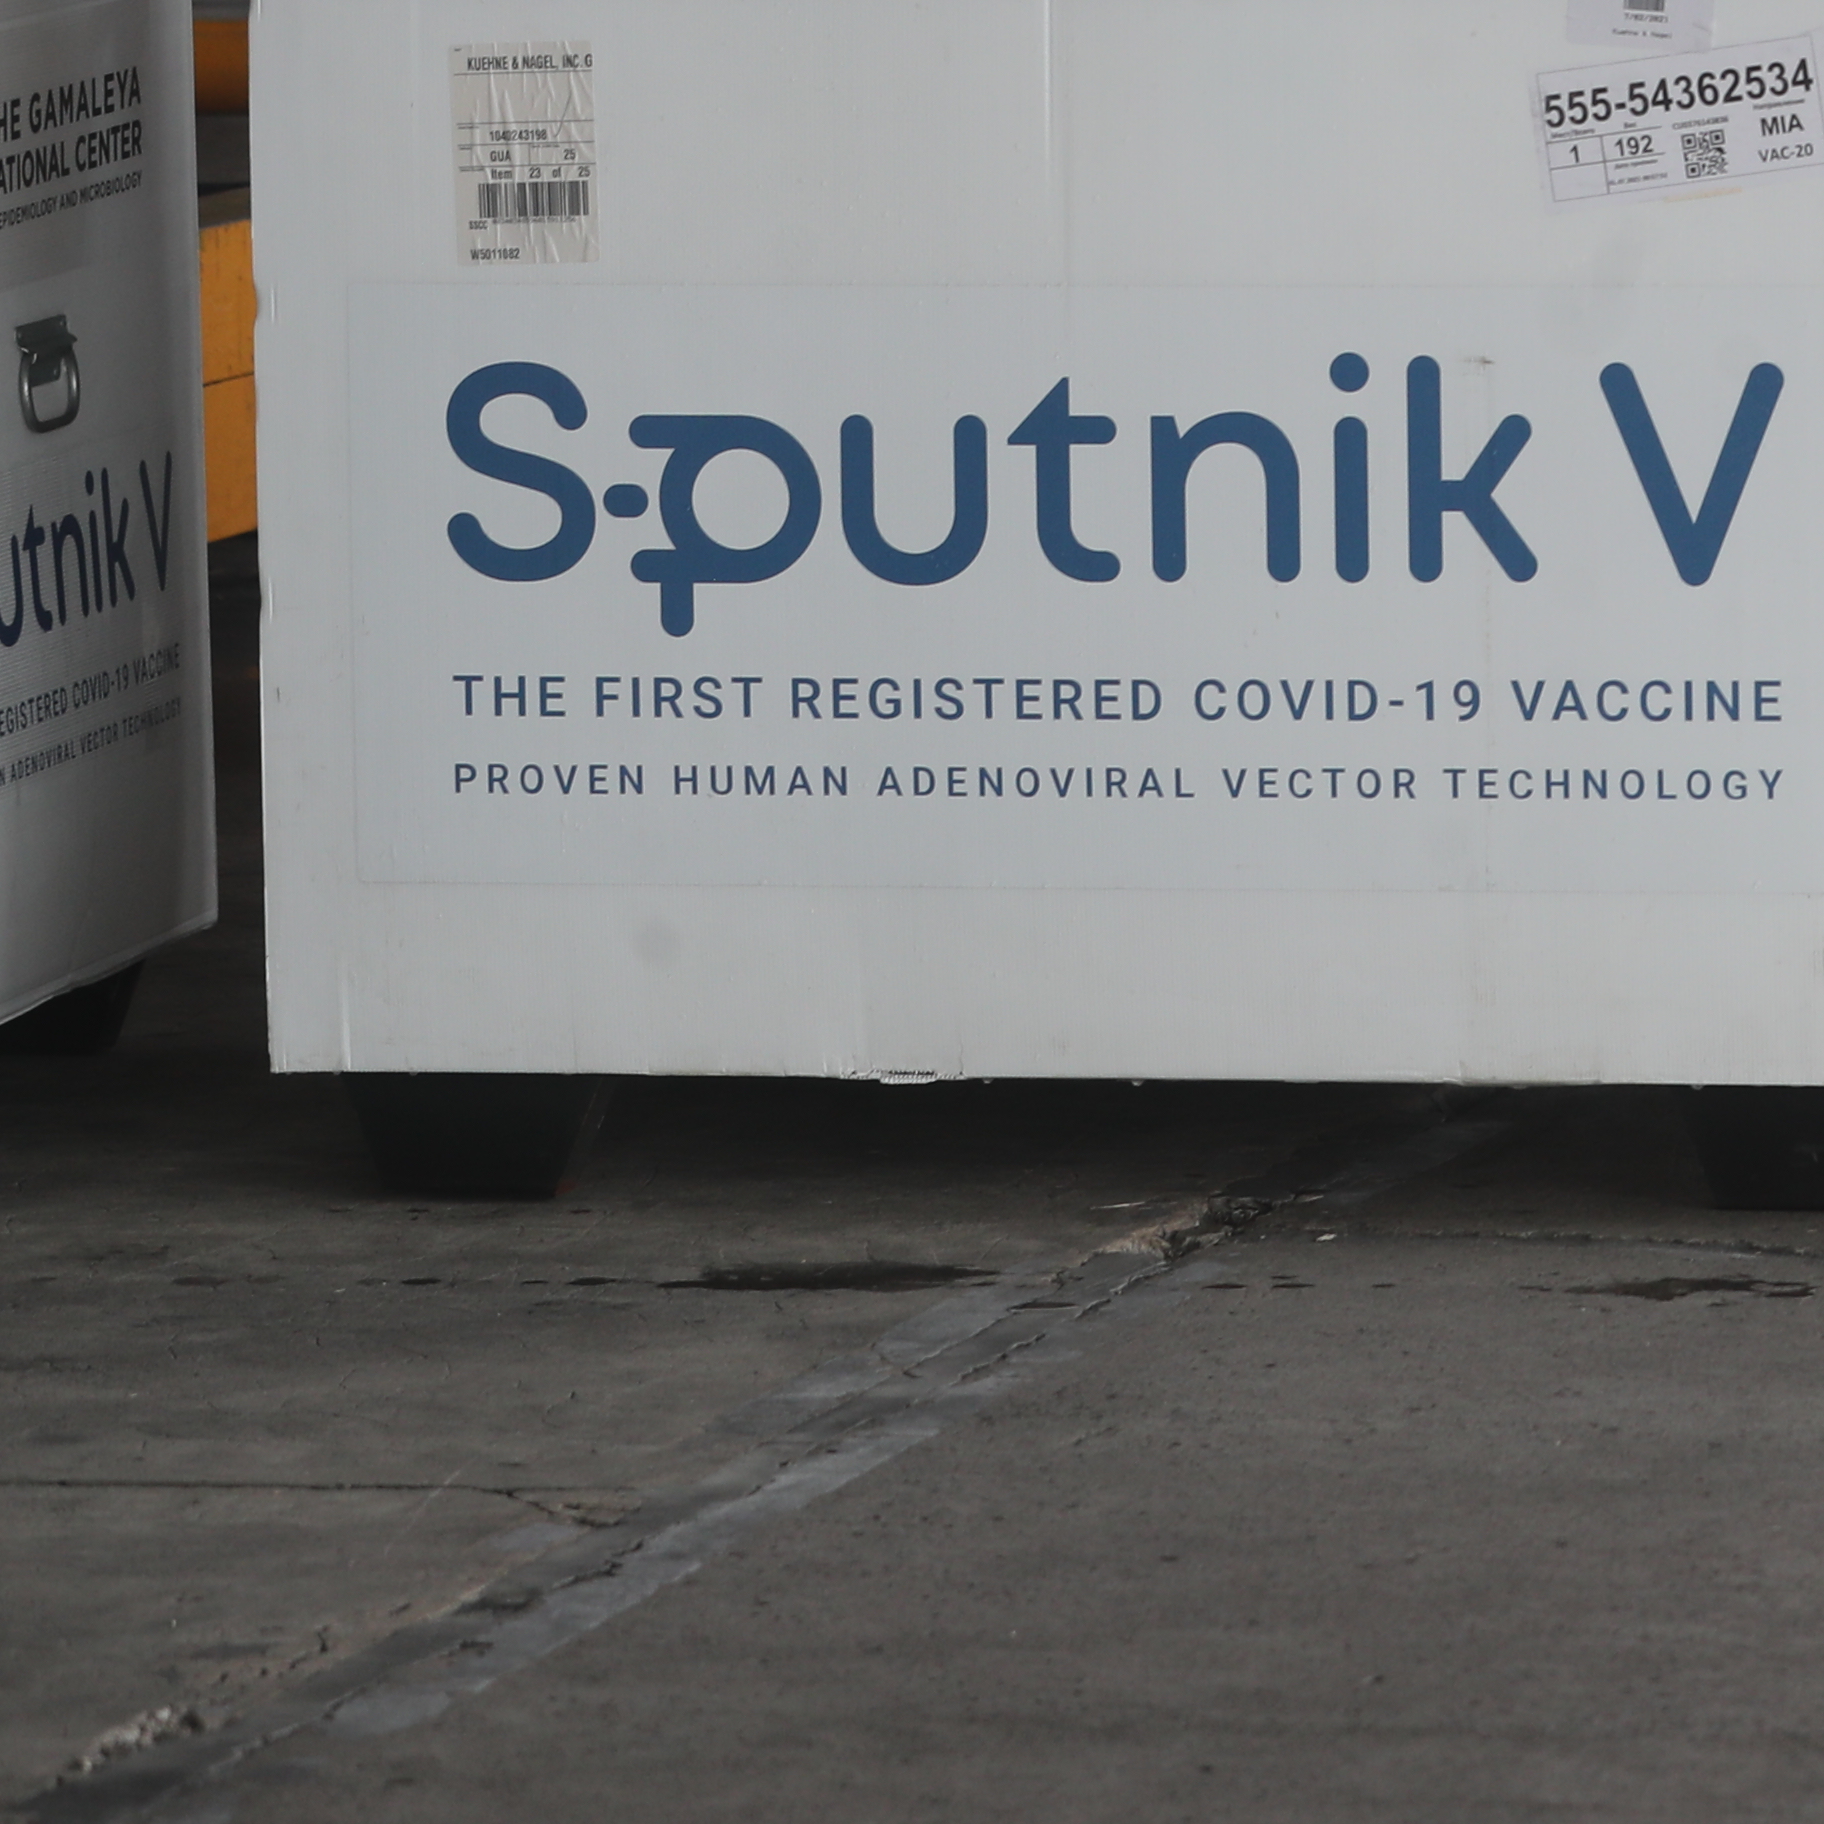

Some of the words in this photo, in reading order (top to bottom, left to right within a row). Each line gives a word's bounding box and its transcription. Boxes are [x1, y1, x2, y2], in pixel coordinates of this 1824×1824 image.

[467, 55, 509, 71] KUEHNE
[512, 56, 519, 70] &
[29, 66, 141, 134] GAMALEYA
[1544, 57, 1815, 129] 555-54362534
[1760, 113, 1805, 138] MIA
[0, 141, 70, 194] ATIONAL
[75, 119, 142, 172] CENTER
[490, 150, 512, 163] GUA
[563, 149, 577, 161] 25
[1568, 144, 1581, 164] 1
[1614, 134, 1655, 158] 192
[1757, 142, 1815, 163] VAC-20
[529, 167, 542, 179] 23
[577, 166, 591, 177] 25
[1599, 362, 1784, 586] V
[139, 451, 172, 592] V
[452, 676, 566, 716] THE
[596, 676, 762, 719] FIRST
[792, 678, 1161, 720] REGISTERED
[1195, 679, 1480, 721] COVID-19
[1511, 680, 1781, 722] VACCINE
[455, 764, 643, 794] PROVEN
[674, 765, 847, 796] HUMAN
[877, 766, 1194, 798] ADENOVIRAL
[1222, 768, 1415, 798] VECTOR
[1443, 768, 1782, 800] TECHNOLOGY
